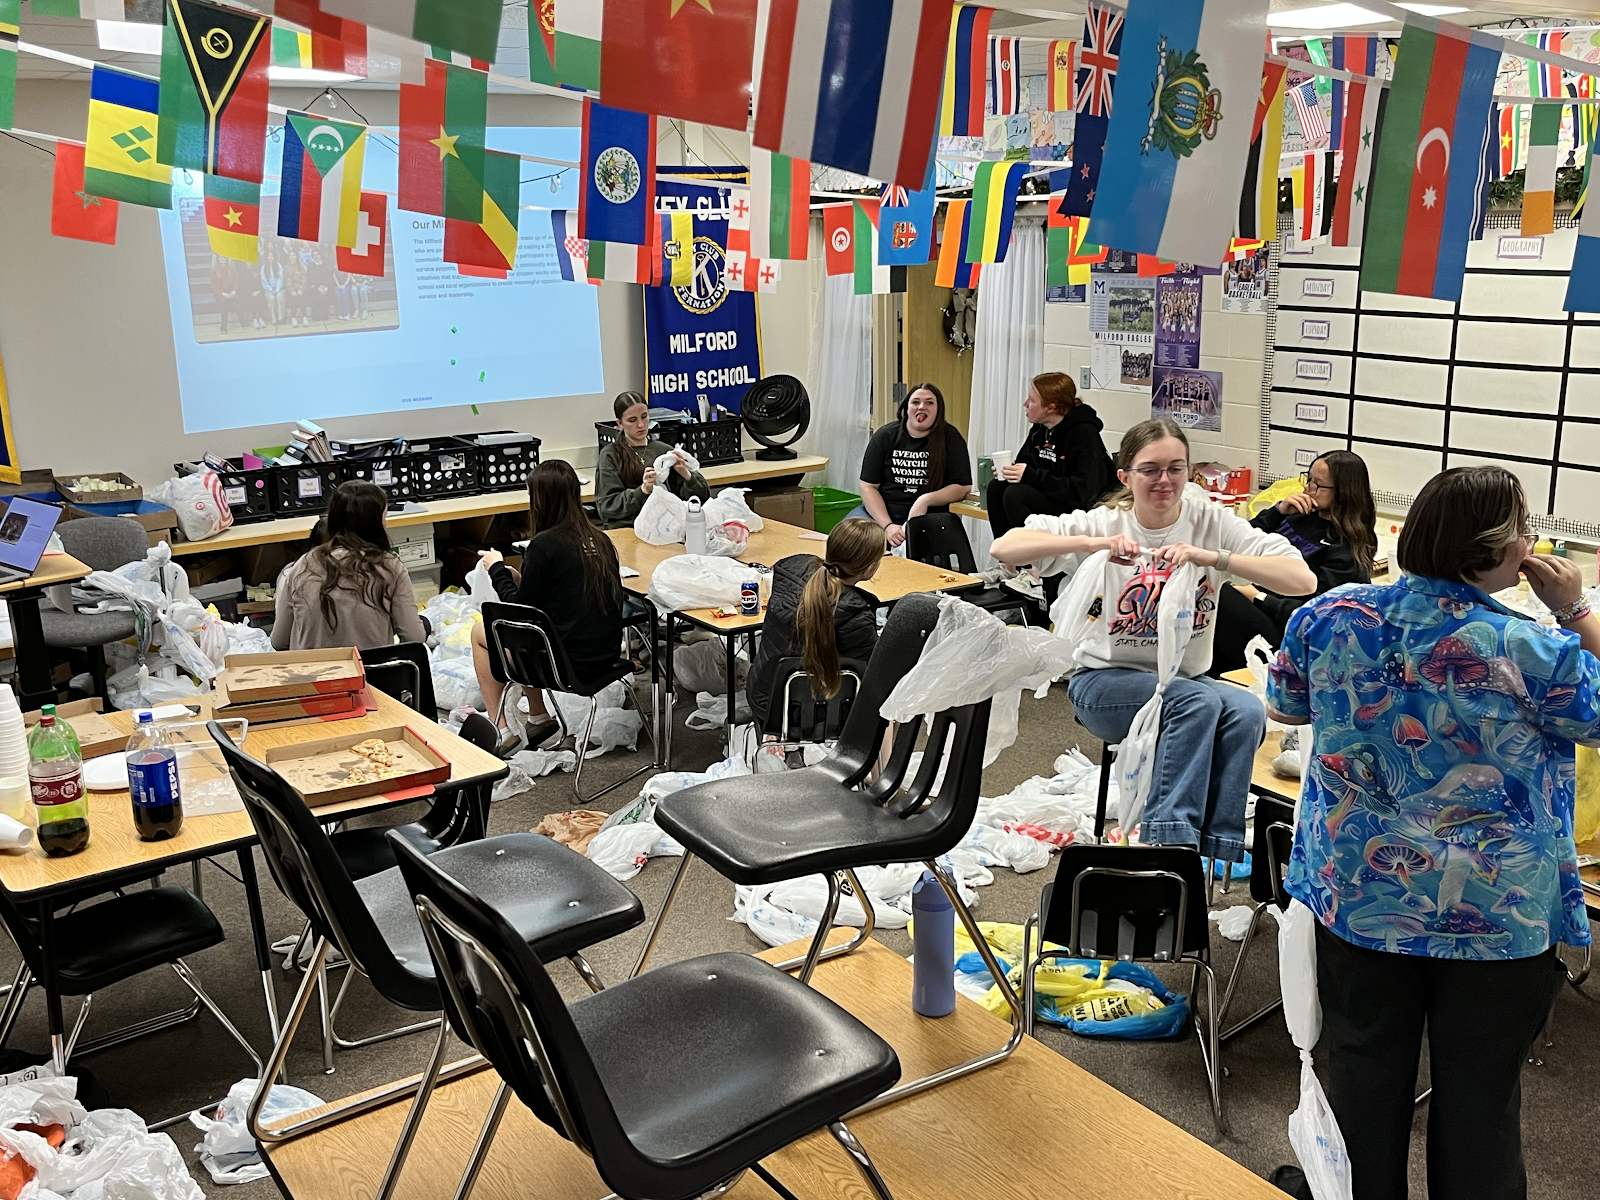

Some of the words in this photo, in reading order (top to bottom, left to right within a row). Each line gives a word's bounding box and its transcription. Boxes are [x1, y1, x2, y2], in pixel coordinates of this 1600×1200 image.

[697, 196, 730, 221] CLU
[412, 220, 430, 229] Our
[700, 243, 719, 260] CLUB
[1502, 241, 1539, 252] GEOGRAPHY
[1094, 281, 1106, 294] M
[1239, 282, 1255, 290] EAGLE
[1306, 283, 1331, 293] MONDAY
[1228, 291, 1261, 299] BASKETBALL
[1305, 324, 1327, 335] TUESDAY
[670, 330, 737, 354] MILFORD
[1095, 332, 1123, 341] MILFORD
[1127, 334, 1152, 343] EAGLES
[1299, 364, 1329, 375] WEDNESDAY
[650, 373, 689, 394] HIGH
[696, 365, 756, 389] SCHOOL
[1173, 412, 1199, 420] MILFORD
[1299, 407, 1324, 418] THURSDAY
[892, 450, 930, 458] EVERYON
[892, 458, 928, 467] WATCH
[894, 477, 929, 485] SPORTS
[1115, 638, 1139, 647] STATE
[167, 761, 179, 800] PEPSI
